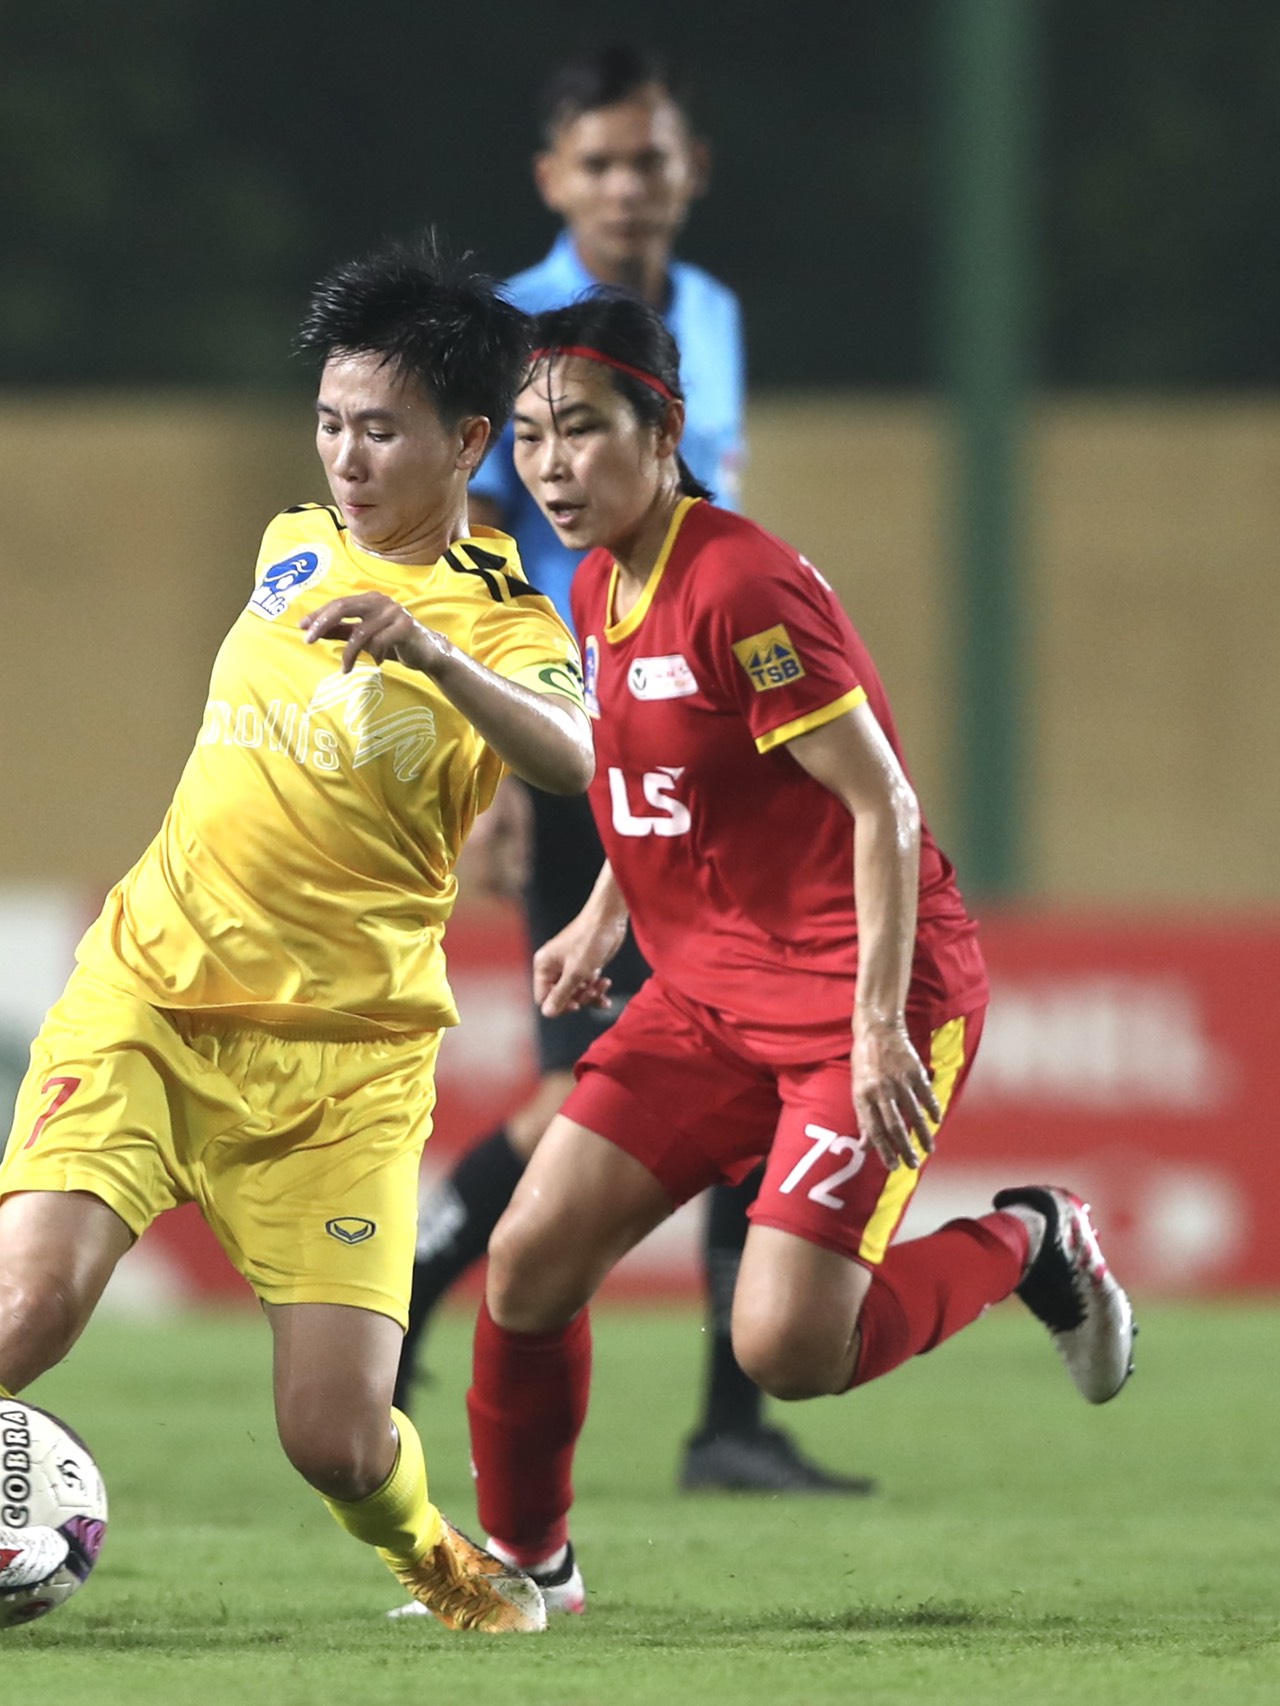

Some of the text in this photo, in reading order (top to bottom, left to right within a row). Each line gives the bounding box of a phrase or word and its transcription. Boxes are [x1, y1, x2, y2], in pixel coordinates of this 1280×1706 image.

[751, 658, 801, 687] TSB
[607, 765, 692, 837] LS
[24, 1076, 82, 1150] 7
[778, 1123, 867, 1210] 72
[0, 1409, 32, 1529] COBRA
